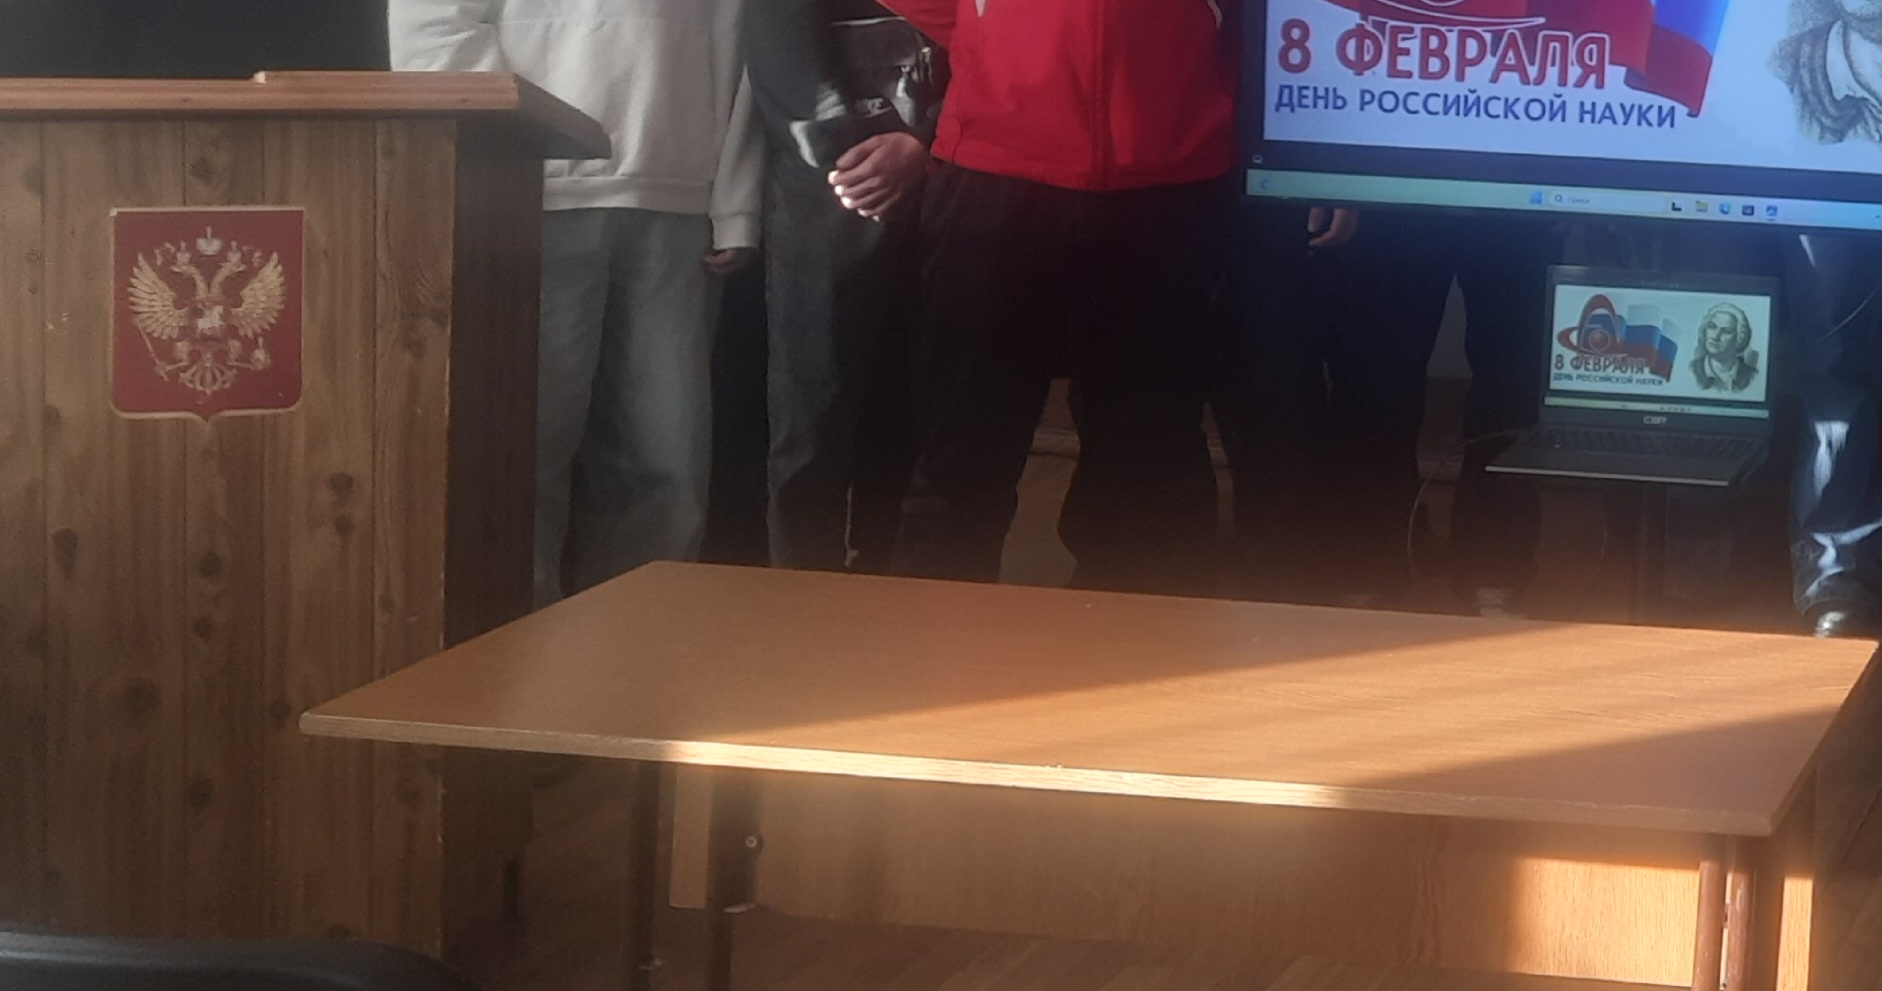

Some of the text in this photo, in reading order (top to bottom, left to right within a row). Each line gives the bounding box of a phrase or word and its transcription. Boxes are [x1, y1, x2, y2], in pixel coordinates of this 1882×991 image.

[1277, 18, 1611, 89] 8 ФЕВРАЛЯ
[1274, 84, 1676, 129] ДЕНЬ РОССИЙСКОЙ НАУКИ
[1554, 354, 1645, 374] 8 ФЕВРАЛЯ
